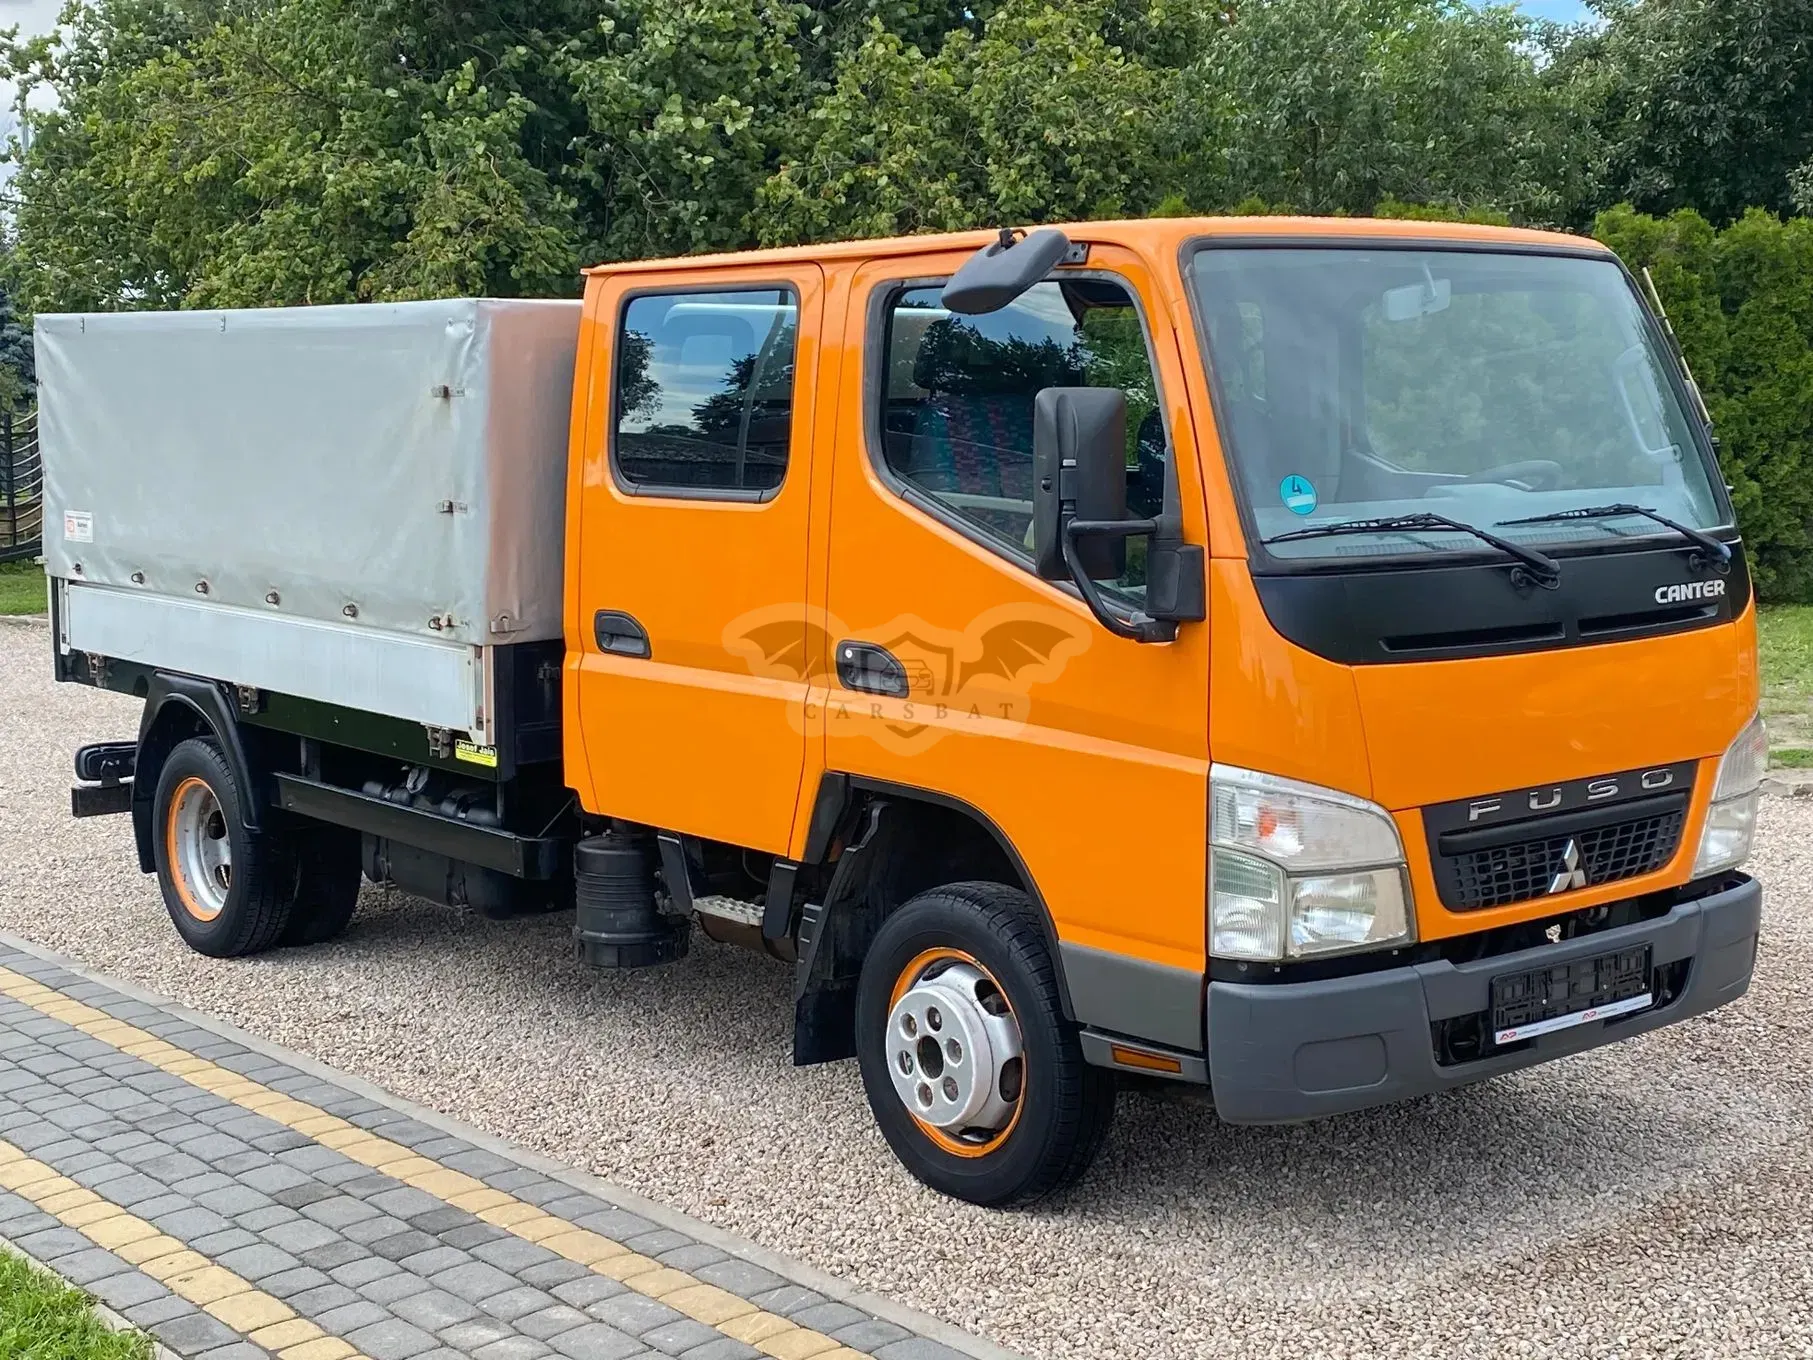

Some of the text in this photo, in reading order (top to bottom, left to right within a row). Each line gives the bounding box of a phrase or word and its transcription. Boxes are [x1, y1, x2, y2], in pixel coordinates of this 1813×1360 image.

[1291, 476, 1303, 495] 4
[1655, 579, 1726, 604] CANTER
[1468, 768, 1674, 821] FUSO
